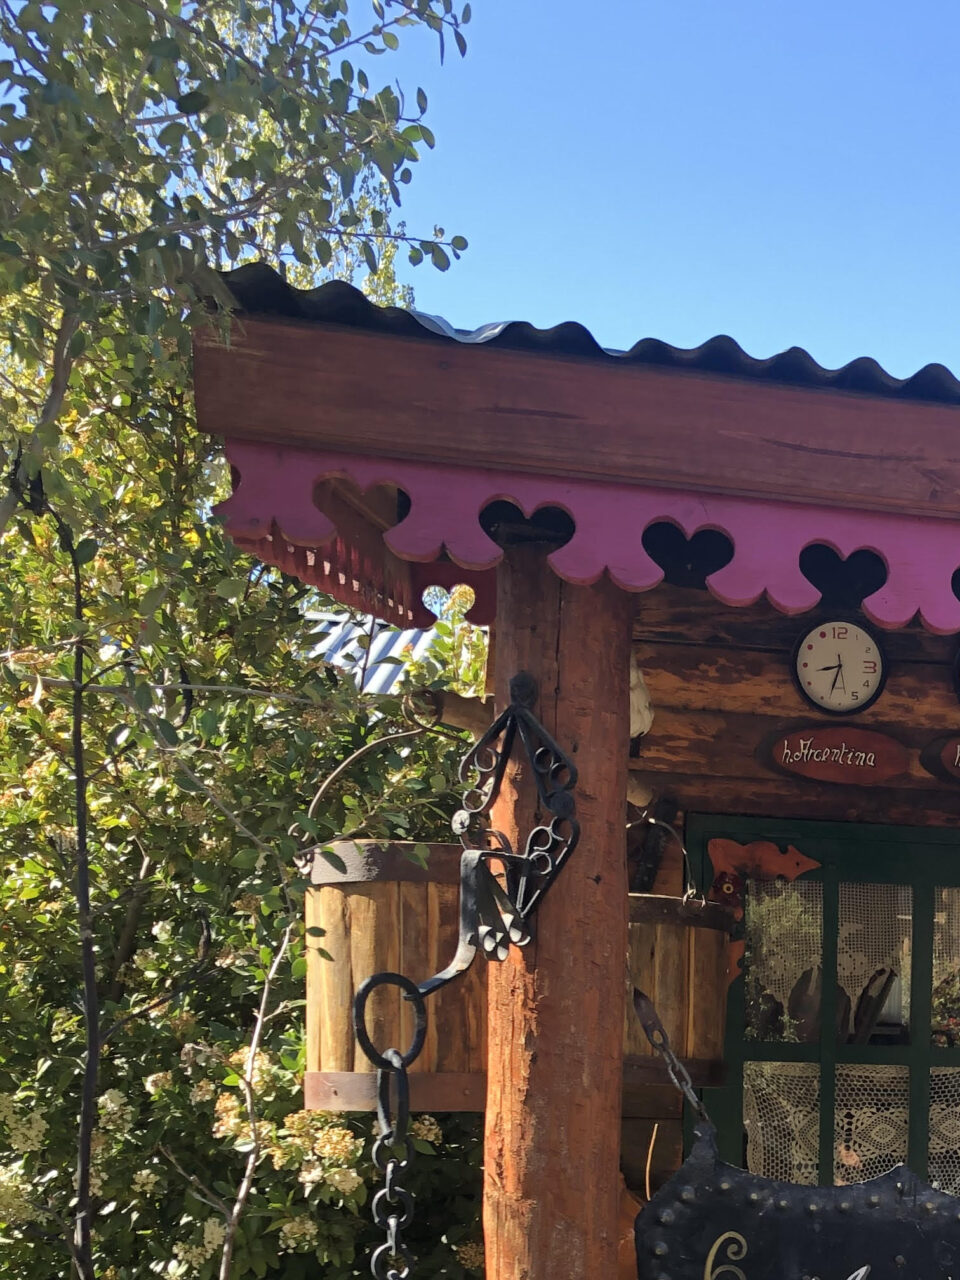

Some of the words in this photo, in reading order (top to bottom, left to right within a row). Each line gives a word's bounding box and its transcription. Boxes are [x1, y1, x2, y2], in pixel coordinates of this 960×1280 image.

[831, 626, 849, 640] 12
[864, 646, 872, 654] 2
[862, 660, 877, 674] 3
[862, 679, 871, 689] 4
[850, 691, 859, 701] 5
